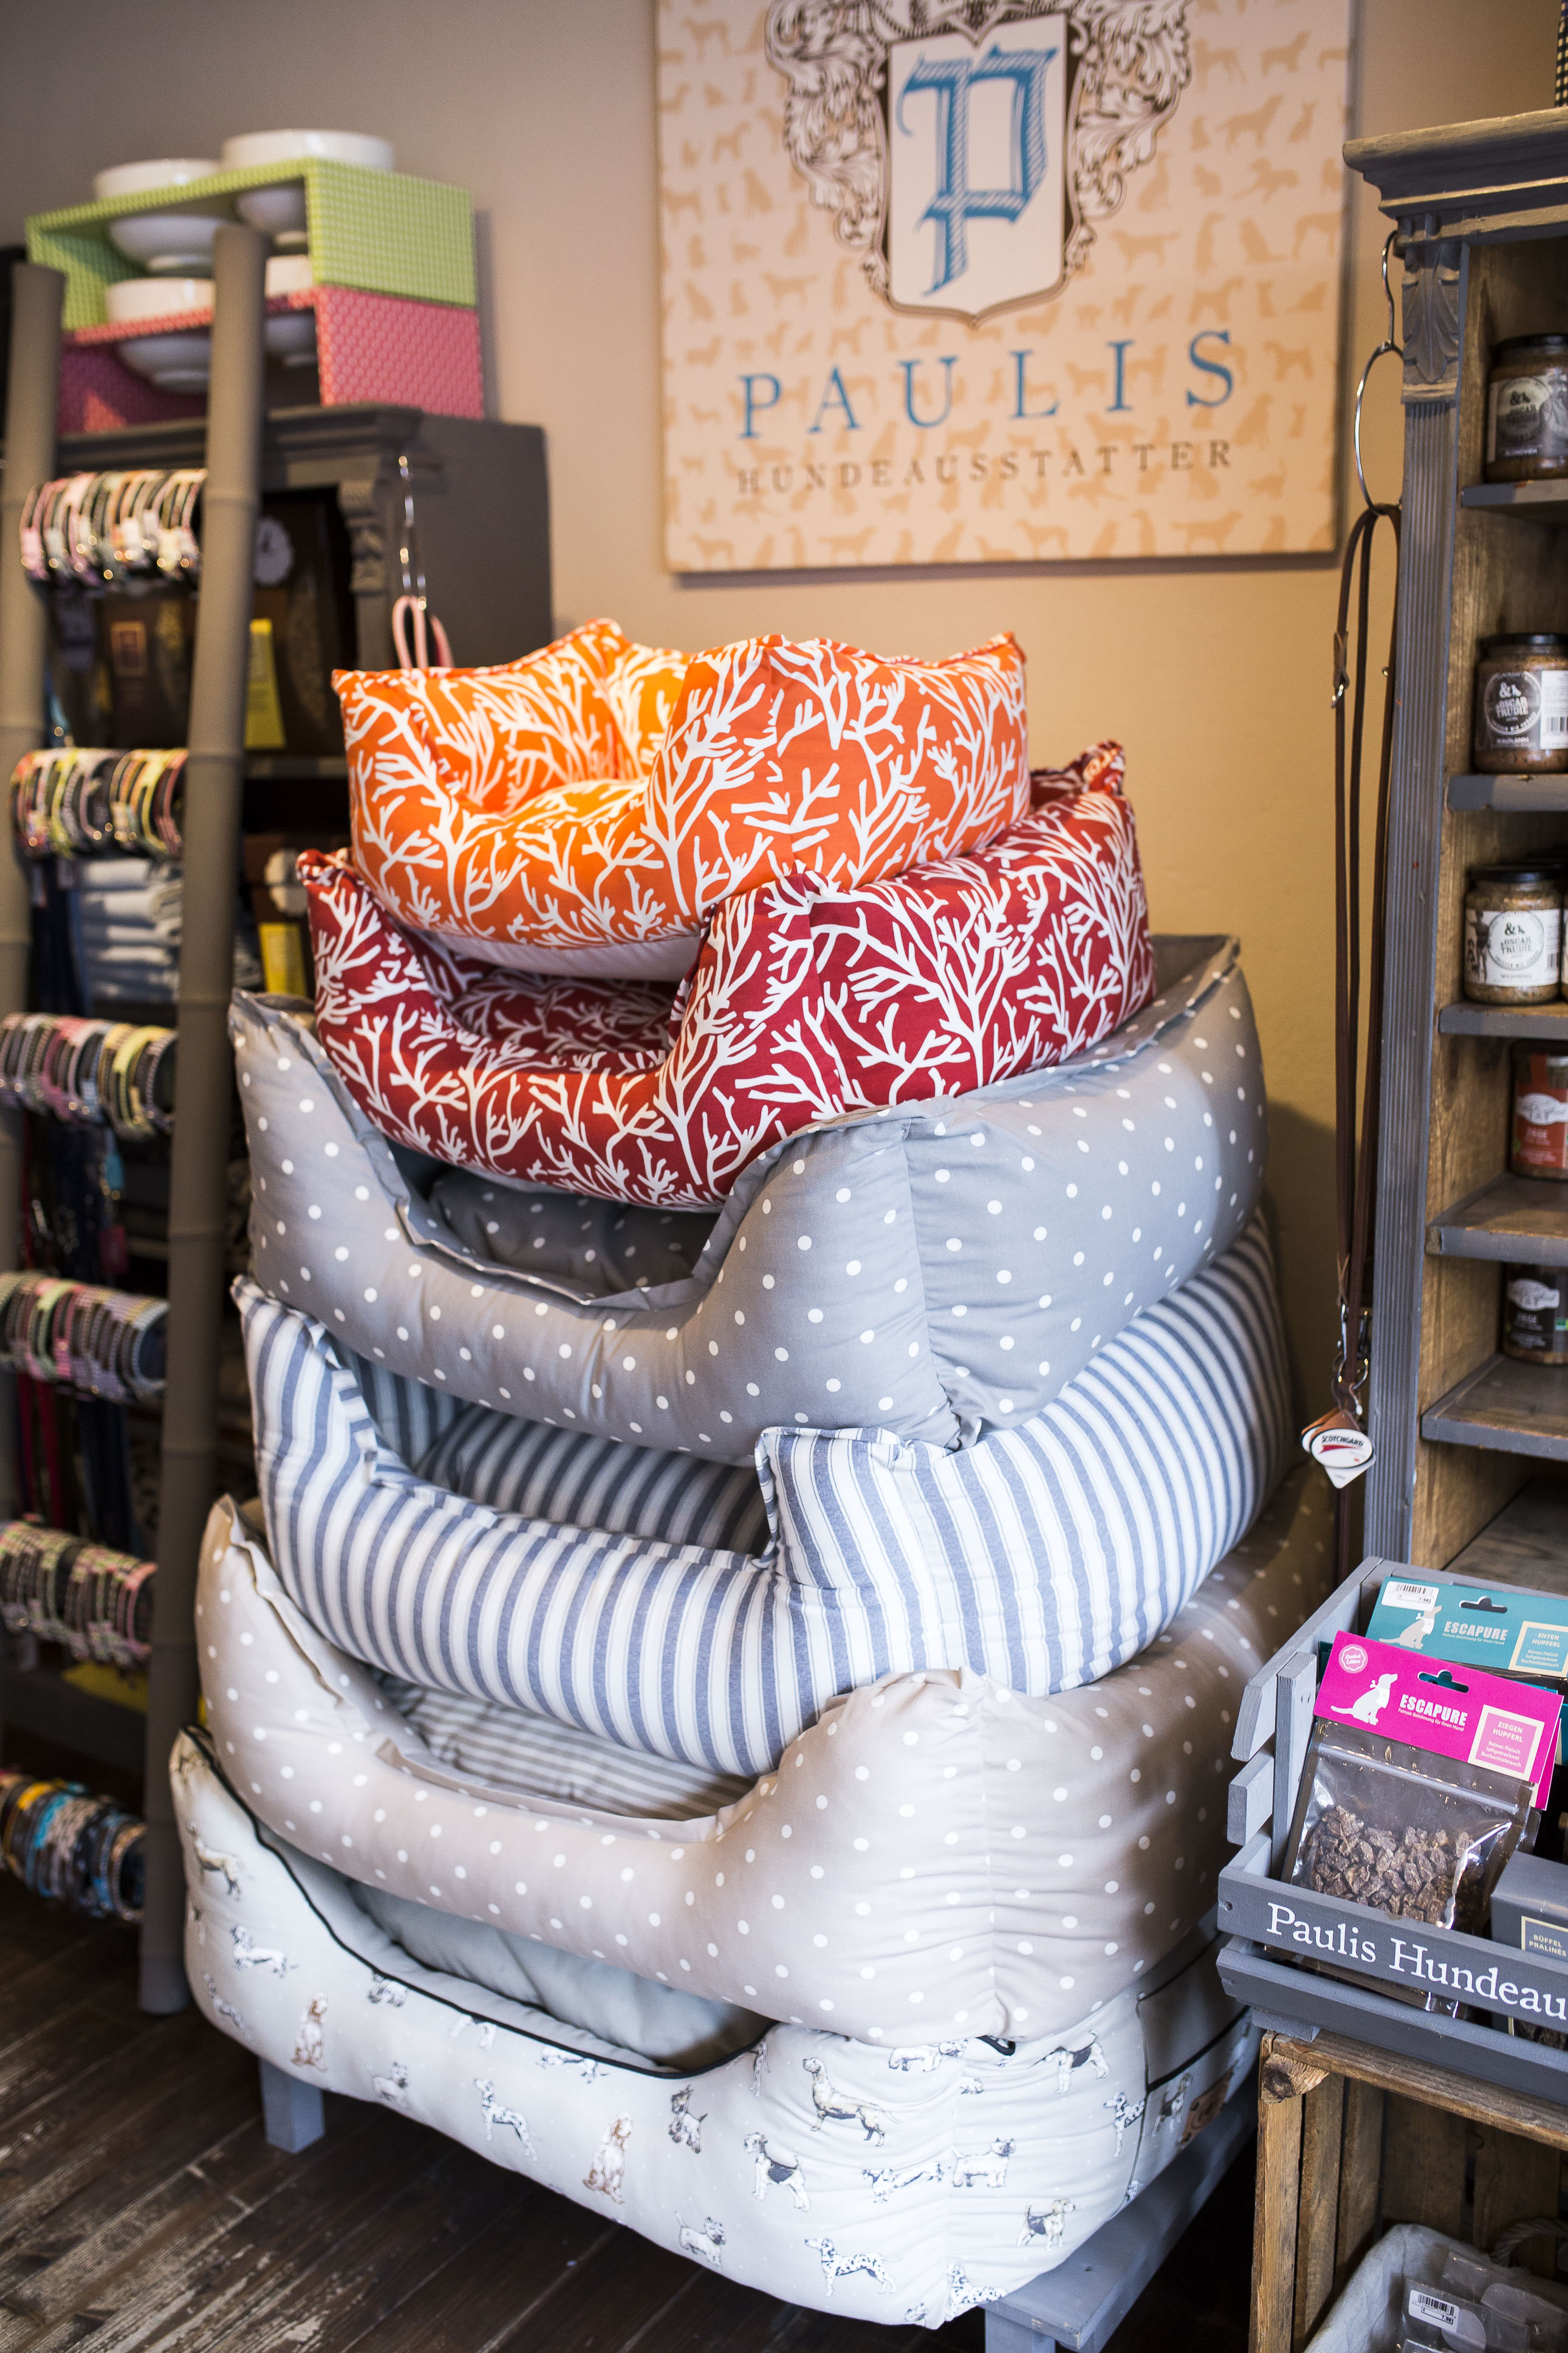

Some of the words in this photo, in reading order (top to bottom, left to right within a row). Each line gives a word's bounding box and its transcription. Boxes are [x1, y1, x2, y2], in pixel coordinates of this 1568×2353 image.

[736, 330, 1236, 440] PAULIS
[737, 439, 1231, 496] HUNDEAUSSTATTER
[1443, 1621, 1508, 1641] ESCAPURE
[1532, 1639, 1560, 1647] HUPFERL
[1521, 1658, 1559, 1668] Buchenholzrauch
[1399, 1694, 1468, 1726] ESCAPURE
[1412, 1712, 1434, 1723] Belohnung
[1497, 1721, 1523, 1734] ZIEGEN
[1493, 1728, 1523, 1743] HUPFERL
[1485, 1747, 1520, 1760] luftgetrocknet
[1488, 1740, 1504, 1750] Reines
[1504, 1745, 1521, 1755] Fleisch
[1481, 1751, 1521, 1768] Buchenholzrauch
[1533, 1934, 1562, 1948] BÜFFEL
[1266, 1902, 1377, 1963] Paulis
[1389, 1937, 1567, 2021] Hundeau
